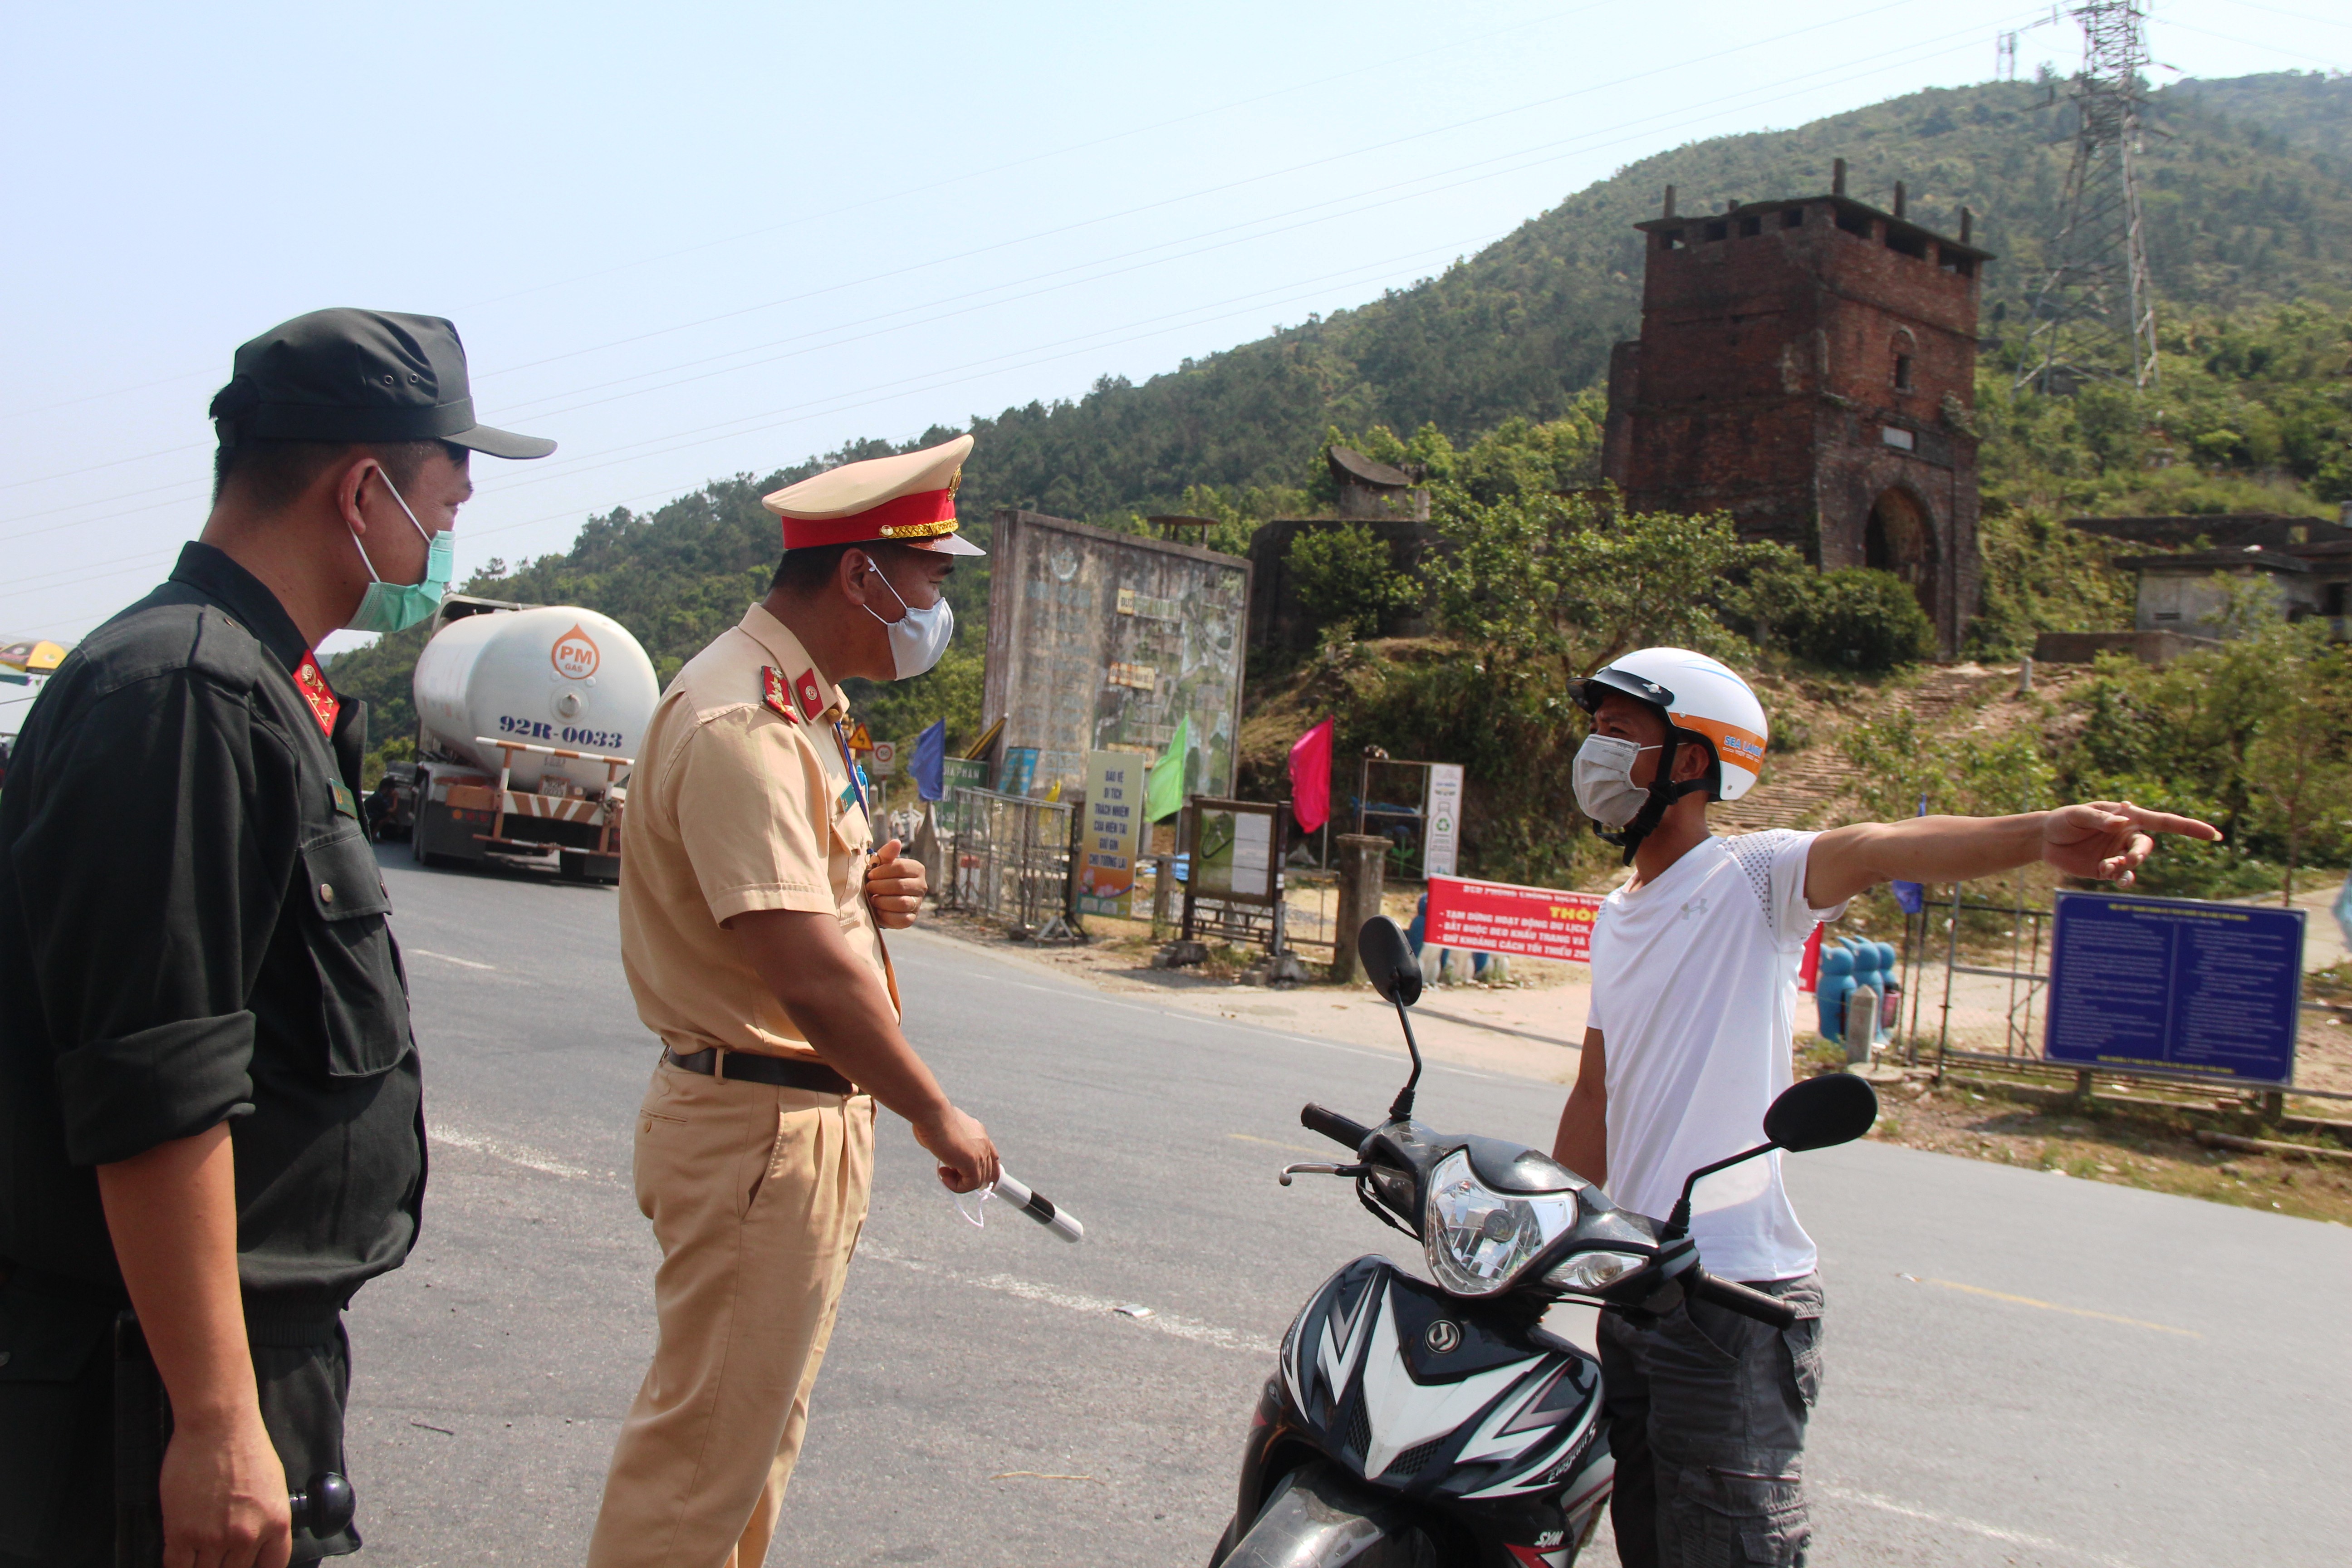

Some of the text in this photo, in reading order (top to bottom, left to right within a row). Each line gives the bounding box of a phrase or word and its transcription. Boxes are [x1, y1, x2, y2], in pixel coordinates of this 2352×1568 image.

[560, 645, 593, 665] PM
[565, 663, 583, 673] GAS
[500, 715, 623, 749] 92R-0033
[1724, 735, 1741, 750] SEA
[1446, 910, 1466, 920] TẠM
[1466, 911, 1494, 923] DỪNG
[1494, 915, 1520, 926] HOẠT
[1549, 921, 1564, 931] DU
[1459, 935, 1498, 948] KHOẢNG
[1498, 939, 1525, 952] CÁCH
[1462, 924, 1489, 935] BUỘC
[1538, 932, 1571, 945] TRANG
[1572, 936, 1586, 946] VÀ
[1534, 1530, 1564, 1548] SYM
